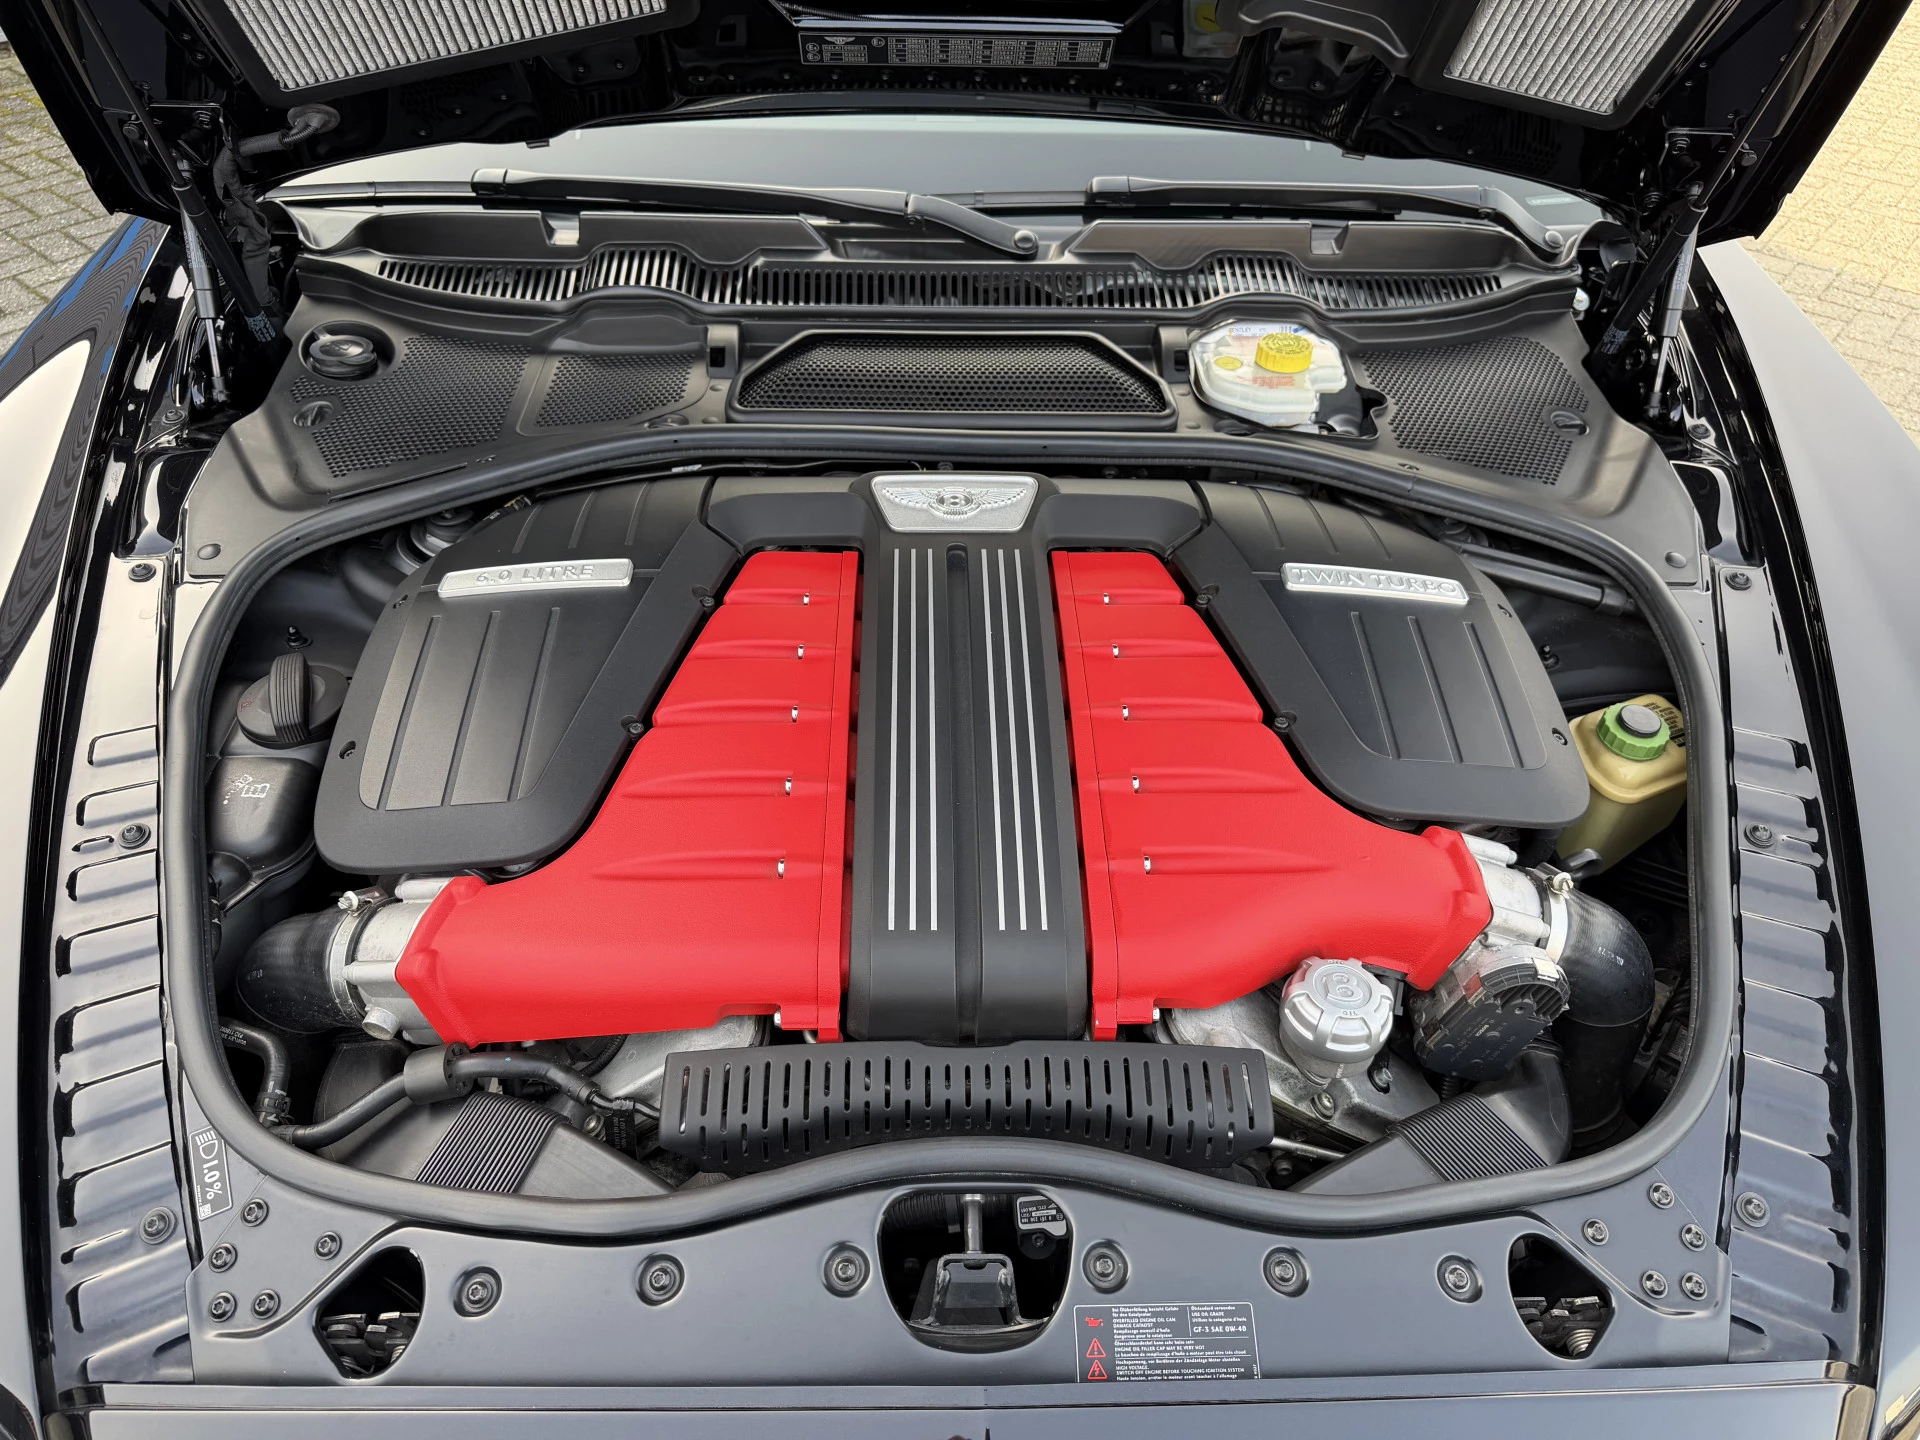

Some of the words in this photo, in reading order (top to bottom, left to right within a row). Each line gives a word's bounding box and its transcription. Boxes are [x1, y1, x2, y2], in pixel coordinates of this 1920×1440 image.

[476, 569, 512, 584] 6.0
[522, 565, 594, 582] LITRE
[1291, 568, 1366, 585] TWIN
[1370, 575, 1457, 593] TURBO
[203, 1159, 222, 1200] 1.0%
